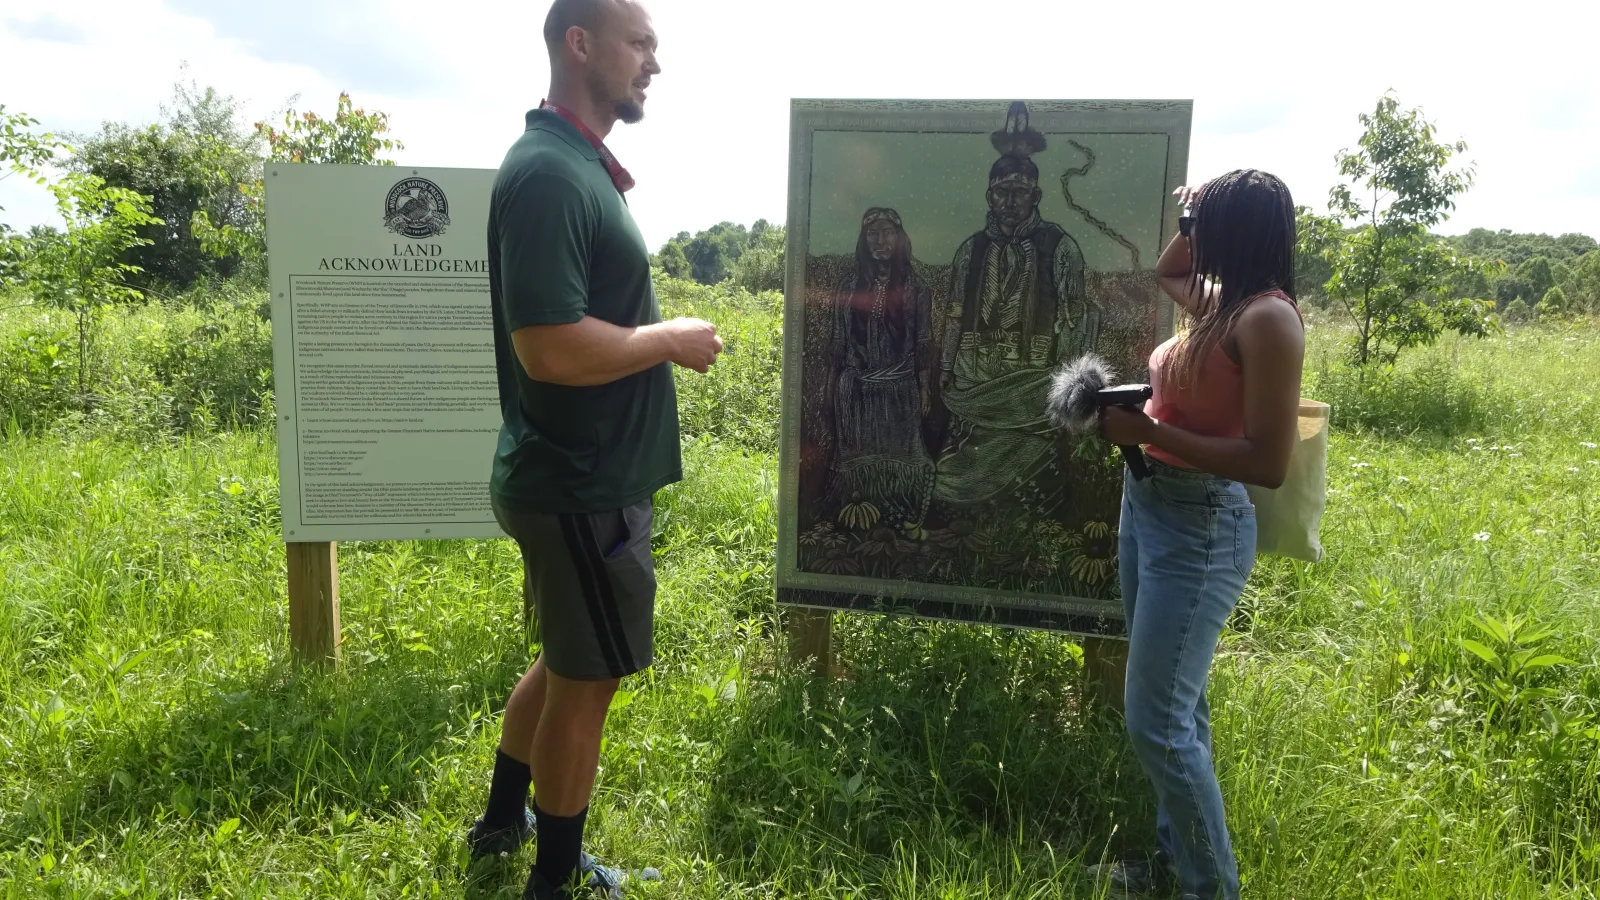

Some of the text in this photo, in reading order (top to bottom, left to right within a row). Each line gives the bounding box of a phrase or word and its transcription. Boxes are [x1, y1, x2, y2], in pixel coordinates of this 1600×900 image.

[389, 181, 444, 210] WOODCOCK NATURE PRESERVE
[393, 244, 442, 256] LAND
[318, 258, 489, 272] ACKNOWLEDGEME
